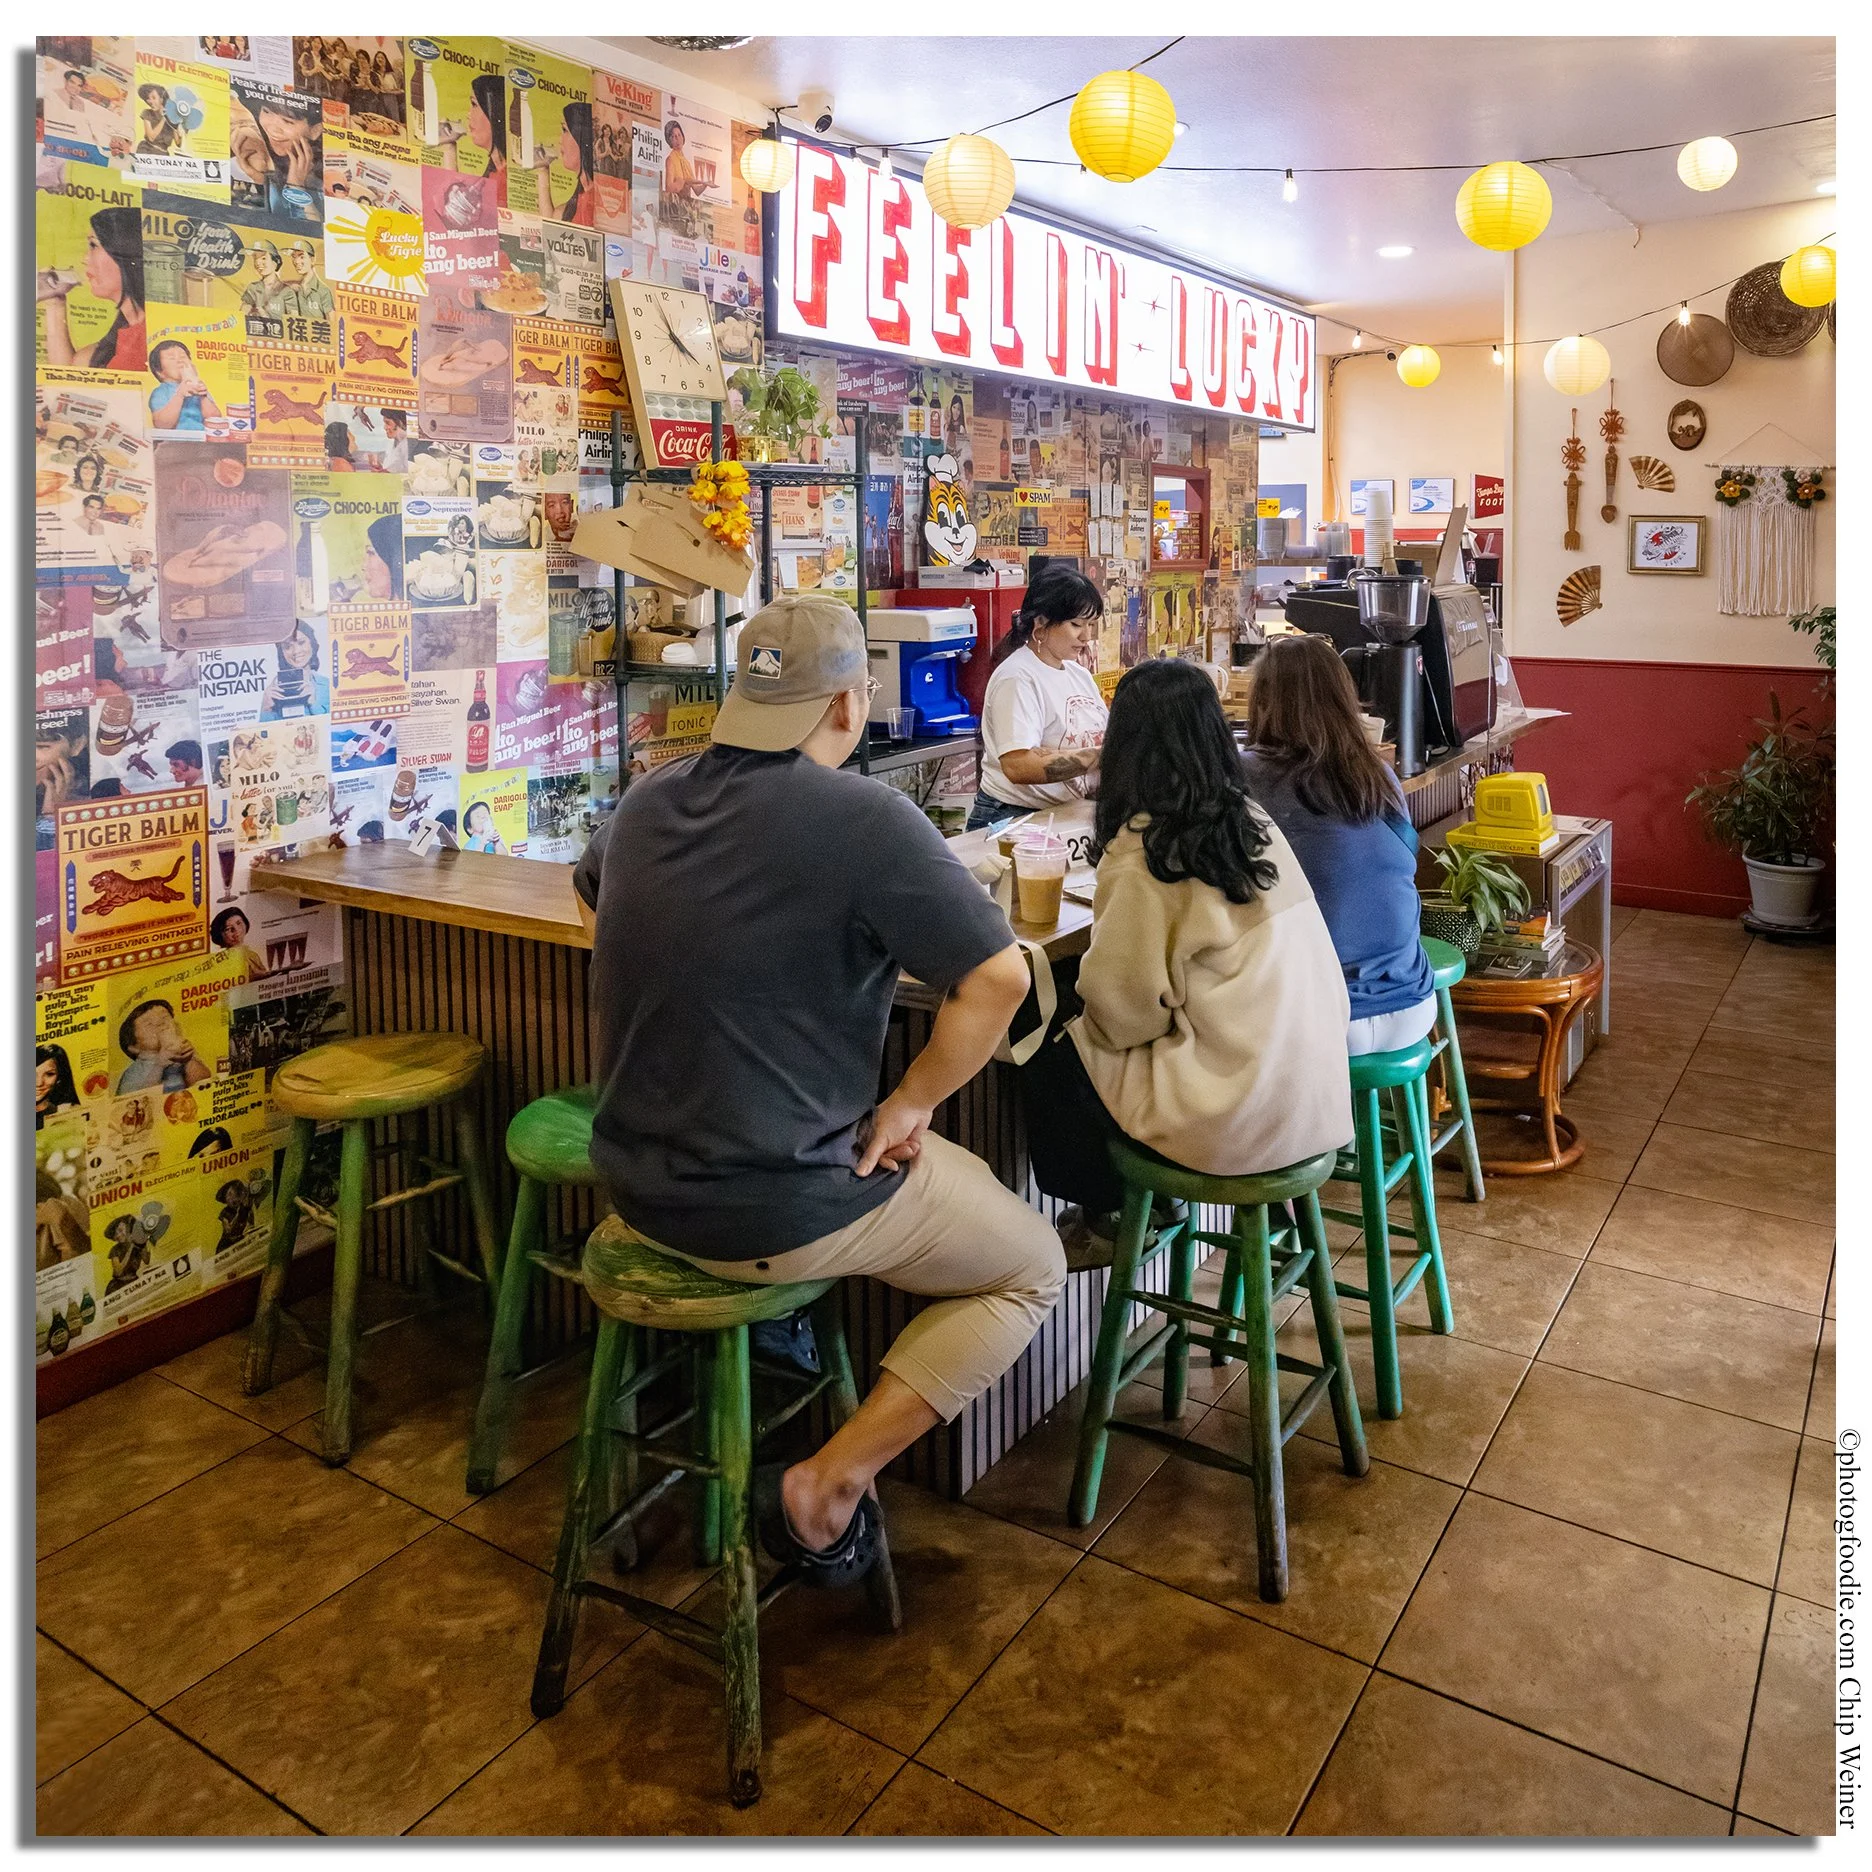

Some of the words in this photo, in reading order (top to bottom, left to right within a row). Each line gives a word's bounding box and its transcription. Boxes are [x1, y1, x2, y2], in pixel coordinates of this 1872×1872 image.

[443, 49, 500, 75] CHOCO-LAIT
[179, 65, 214, 80] ELECTRIC
[231, 75, 257, 89] Peak
[538, 78, 588, 103] CHOCO-LAIT
[245, 89, 265, 100] you
[266, 93, 285, 105] can
[286, 98, 308, 110] see!
[155, 159, 183, 169] TUNAY
[186, 160, 198, 168] NA
[380, 231, 419, 247] Lucky
[429, 231, 446, 241] San
[448, 229, 478, 240] Miguel
[479, 228, 498, 237] Beer
[187, 238, 235, 255] Health
[390, 245, 423, 259] Tigre
[547, 239, 585, 258] VOLTES
[198, 254, 241, 271] Drink
[424, 261, 455, 275] ang
[456, 251, 500, 272] beer!
[700, 247, 737, 270] Julep
[645, 294, 653, 303] 11
[661, 292, 670, 301] 12
[338, 295, 377, 315] TIGER
[383, 303, 417, 322] BALM
[633, 307, 643, 317] 10
[697, 317, 703, 327] 2
[543, 333, 570, 348] BALM
[635, 330, 642, 340] 9
[196, 340, 248, 353] DARIGOLD
[574, 336, 602, 352] TIGER
[706, 342, 713, 351] 3
[1170, 276, 1309, 423] LUCKY
[196, 351, 227, 361] EVAP
[248, 352, 291, 371] TIGER
[298, 357, 336, 375] BALM
[645, 355, 652, 365] 8
[706, 364, 712, 373] 4
[661, 375, 667, 384] 7
[681, 381, 688, 390] 6
[698, 380, 705, 389] 5
[354, 384, 387, 394] RELIEVING
[388, 388, 419, 397] OINTMENT
[676, 425, 697, 433] DRINK
[1015, 493, 1018, 503] I
[1029, 493, 1051, 504] SPAM
[1480, 497, 1504, 507] FOOT
[334, 501, 400, 515] CHOCO-LAIT
[331, 617, 370, 632] TIGER
[375, 615, 408, 629] BALM
[59, 627, 90, 642] Beer
[198, 650, 223, 662] THE
[199, 658, 266, 682] KODAK
[200, 677, 267, 698] INSTANT
[348, 697, 380, 706] RELIEVING
[411, 699, 434, 708] Silver
[435, 696, 461, 706] Swan.
[41, 717, 69, 730] see!
[501, 718, 516, 731] San
[516, 711, 542, 726] Miguel
[543, 704, 561, 717] Beer
[569, 716, 582, 725] San
[672, 716, 706, 732] TONIC
[495, 745, 522, 763] ang
[524, 724, 561, 750] beer!
[563, 738, 589, 756] ang
[401, 755, 427, 768] SILVER
[430, 753, 452, 764] SWAN
[239, 771, 280, 786] MILO
[232, 792, 240, 800] is
[240, 787, 263, 801] better
[263, 787, 276, 795] for
[278, 783, 297, 792] you!
[493, 793, 527, 804] DARIGOLD
[210, 800, 228, 828] J
[493, 803, 514, 812] EVAP
[64, 822, 132, 850] TIGER
[140, 812, 200, 839] BALM
[417, 826, 433, 848] 7
[66, 946, 92, 960] PAIN
[94, 936, 149, 954] RELIEVING
[152, 925, 203, 942] OINTMENT
[45, 989, 71, 1001] Yung
[74, 983, 95, 994] may
[180, 974, 247, 1000] DARIGOLD
[45, 1000, 67, 1013] pulp
[70, 994, 89, 1004] bits
[180, 995, 219, 1013] EVAP
[45, 1015, 73, 1031] Royal
[213, 1077, 235, 1089] Yung
[237, 1072, 255, 1083] may
[212, 1086, 231, 1099] pulp
[234, 1081, 249, 1092] bits
[212, 1101, 236, 1115] Royal
[198, 1107, 249, 1128] TRUORANGE
[202, 1149, 249, 1174] UNION
[88, 1180, 143, 1209] UNION
